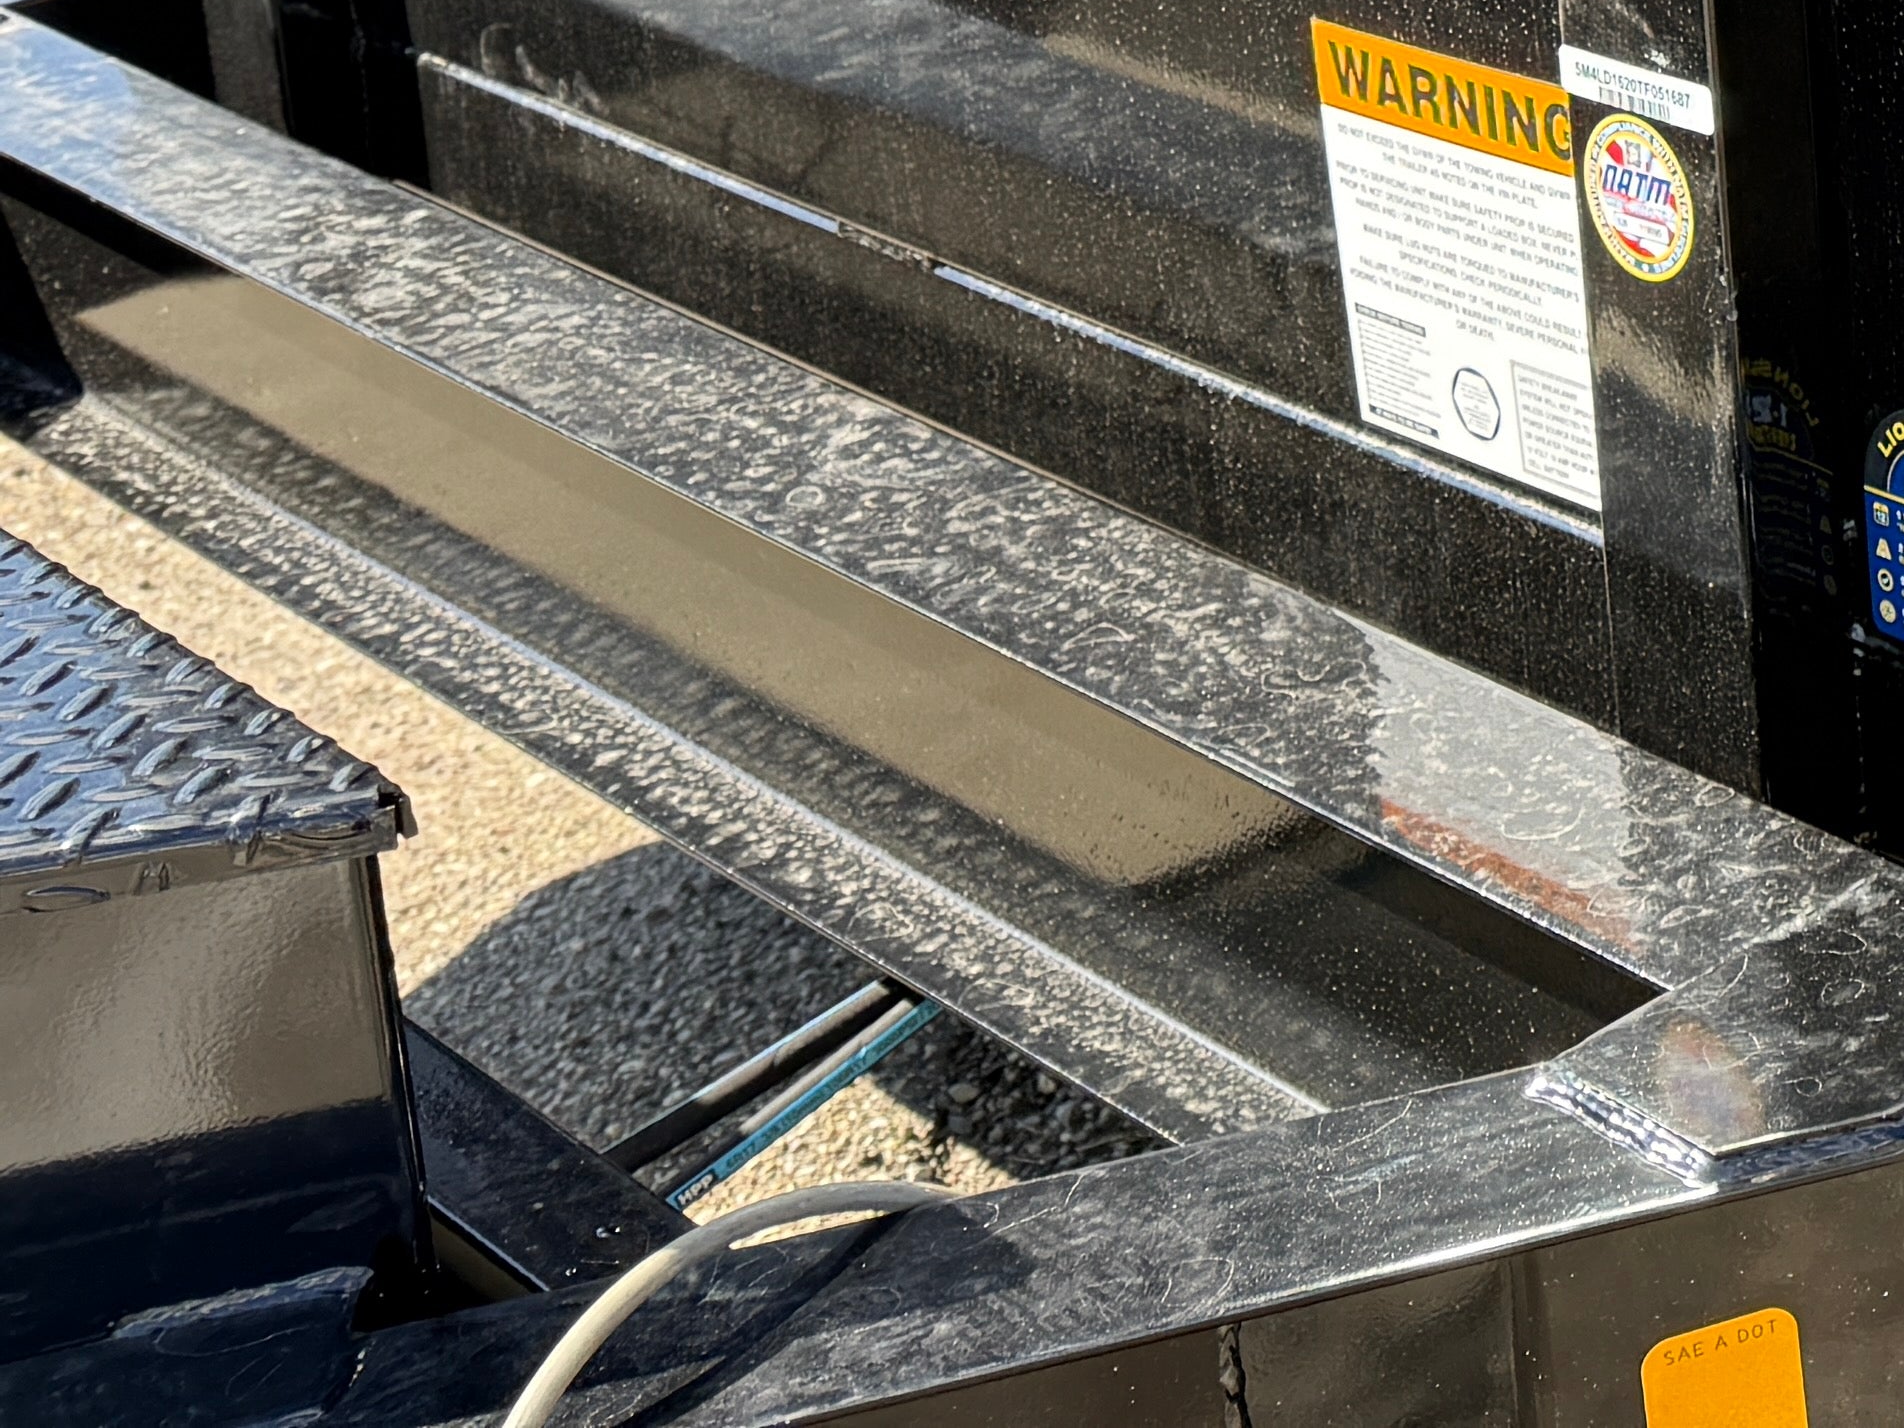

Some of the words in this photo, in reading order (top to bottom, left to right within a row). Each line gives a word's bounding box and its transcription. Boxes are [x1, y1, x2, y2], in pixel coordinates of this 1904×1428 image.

[1328, 40, 1571, 162] WARNING
[676, 1173, 714, 1206] HPP
[1663, 1341, 1704, 1366] SAE
[1715, 1335, 1728, 1351] A
[1737, 1319, 1777, 1343] DOT
